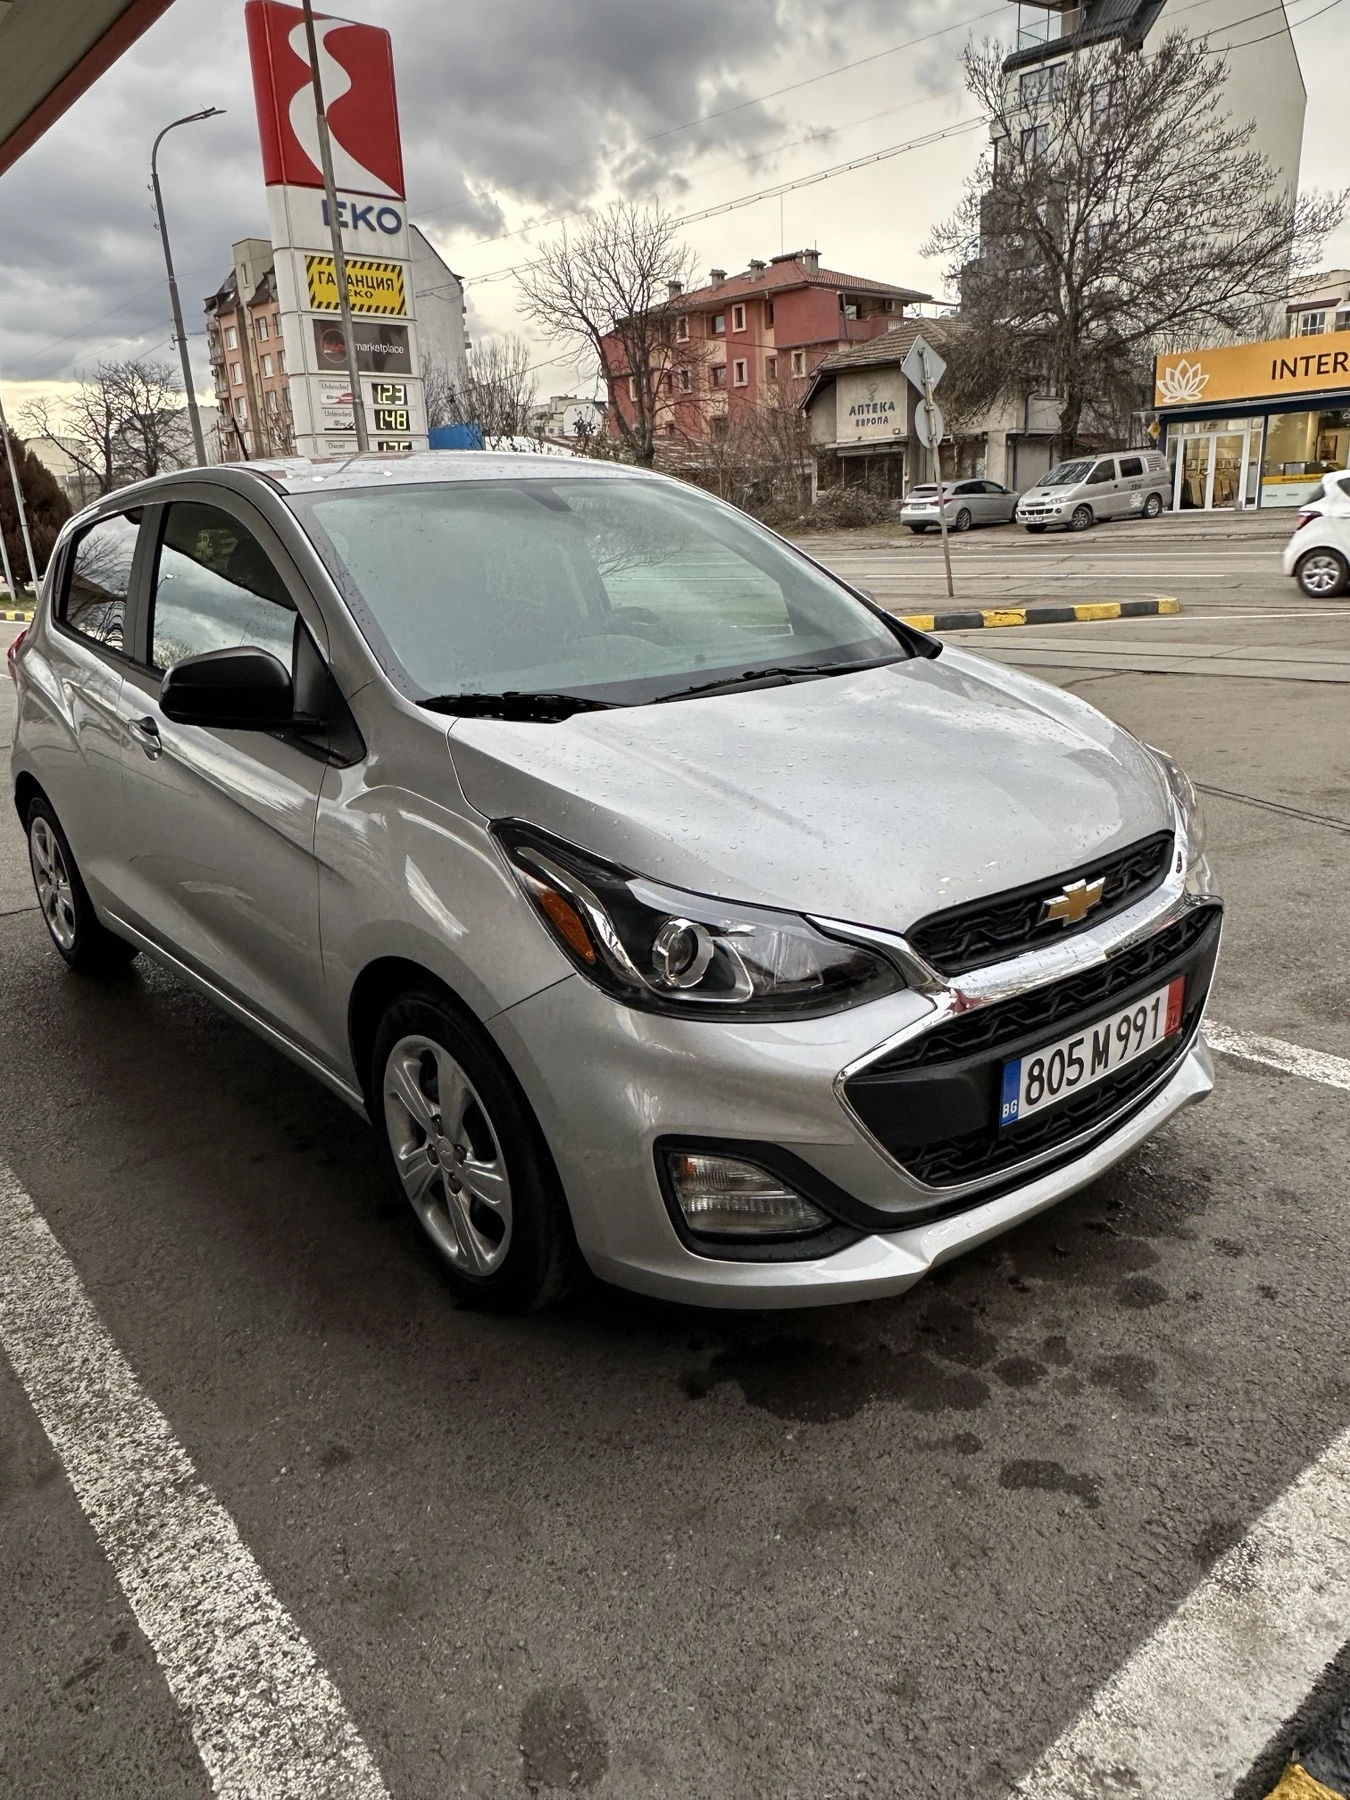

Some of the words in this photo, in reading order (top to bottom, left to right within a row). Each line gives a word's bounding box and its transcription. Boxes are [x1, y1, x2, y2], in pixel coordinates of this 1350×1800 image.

[321, 199, 402, 235] EKO
[318, 271, 395, 292] ГААНЦИЯ
[355, 342, 404, 355] marketplace
[1271, 351, 1349, 380] INTER
[321, 382, 349, 391] Unleaded
[324, 410, 353, 418] Unleaded
[849, 401, 896, 416] АПТЕКА
[855, 416, 889, 427] ЕВРОПА
[1002, 1099, 1018, 1118] BG
